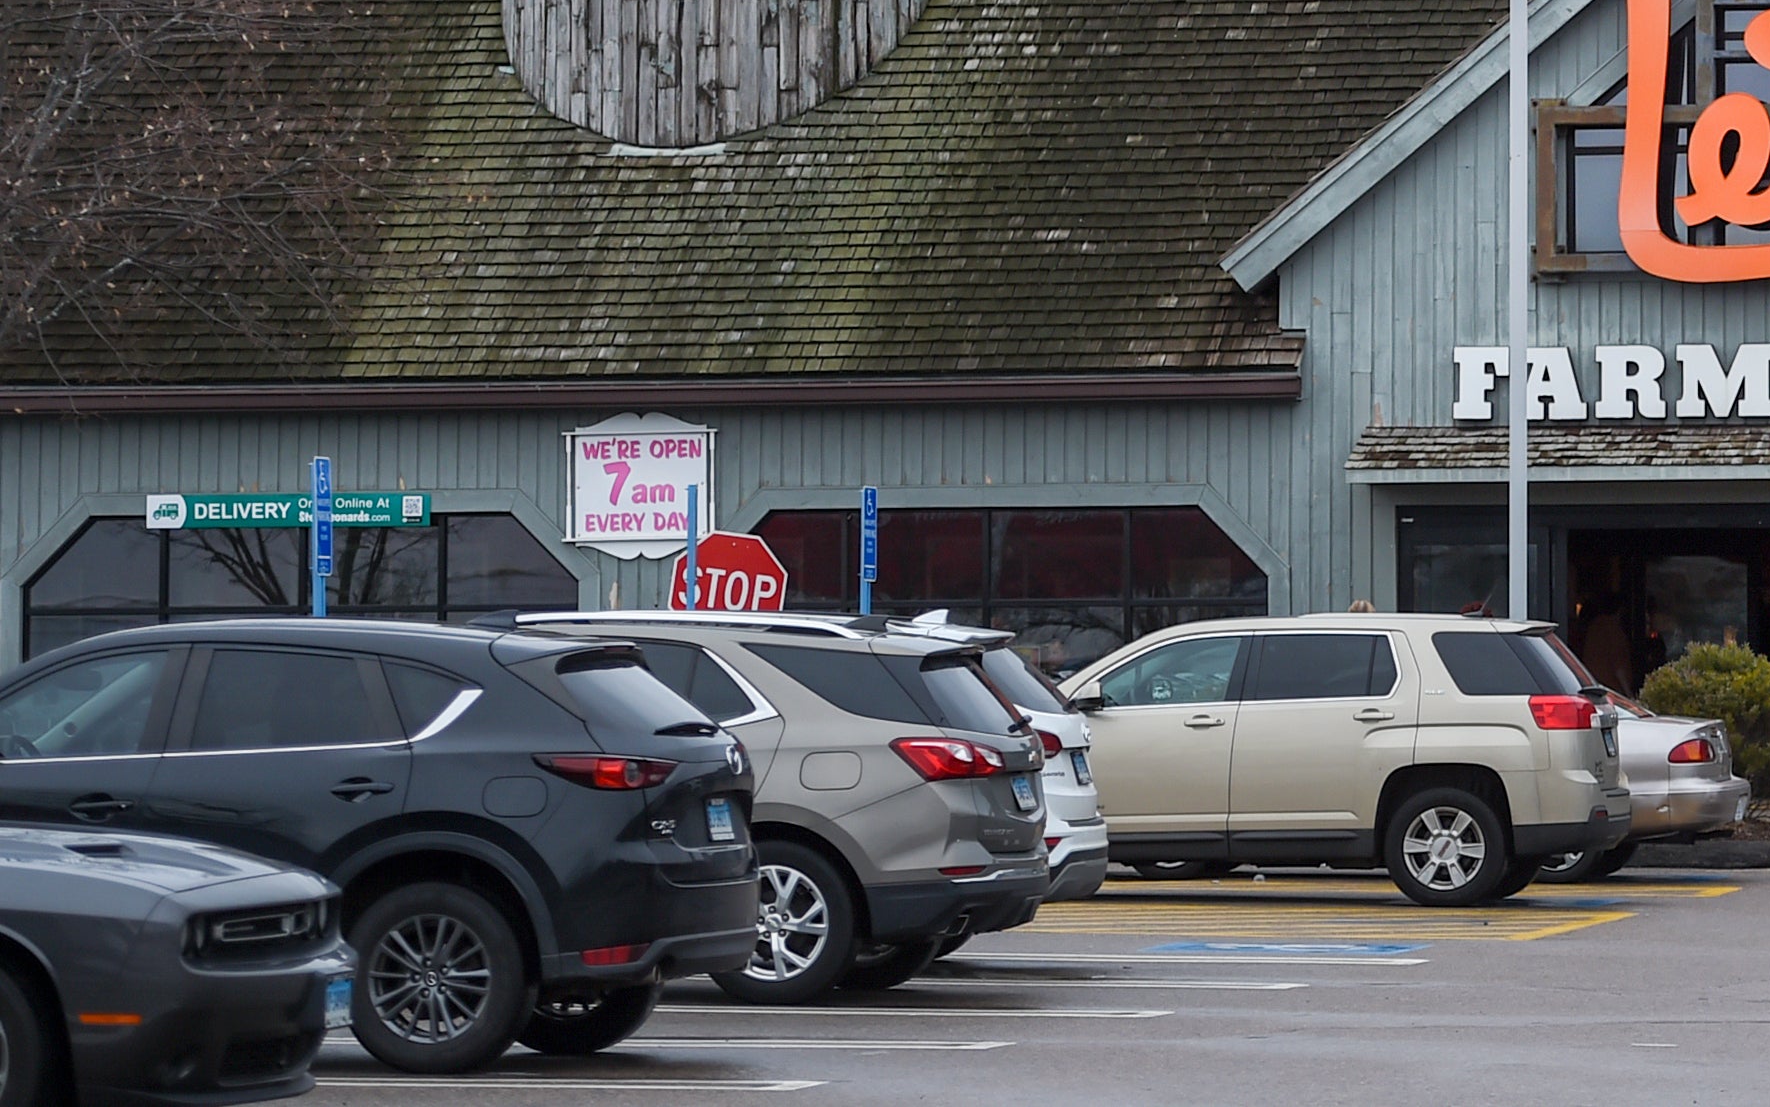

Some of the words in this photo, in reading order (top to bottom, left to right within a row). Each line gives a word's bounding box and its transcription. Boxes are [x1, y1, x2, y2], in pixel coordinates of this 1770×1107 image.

[582, 438, 641, 460] WE'RE
[650, 438, 701, 459] OPEN
[603, 461, 631, 506] 7
[631, 483, 675, 504] am
[194, 502, 291, 520] DELIVERY
[335, 498, 372, 509] Online
[376, 498, 389, 509] At
[585, 513, 645, 532] EVERY
[678, 567, 778, 610] STOP
